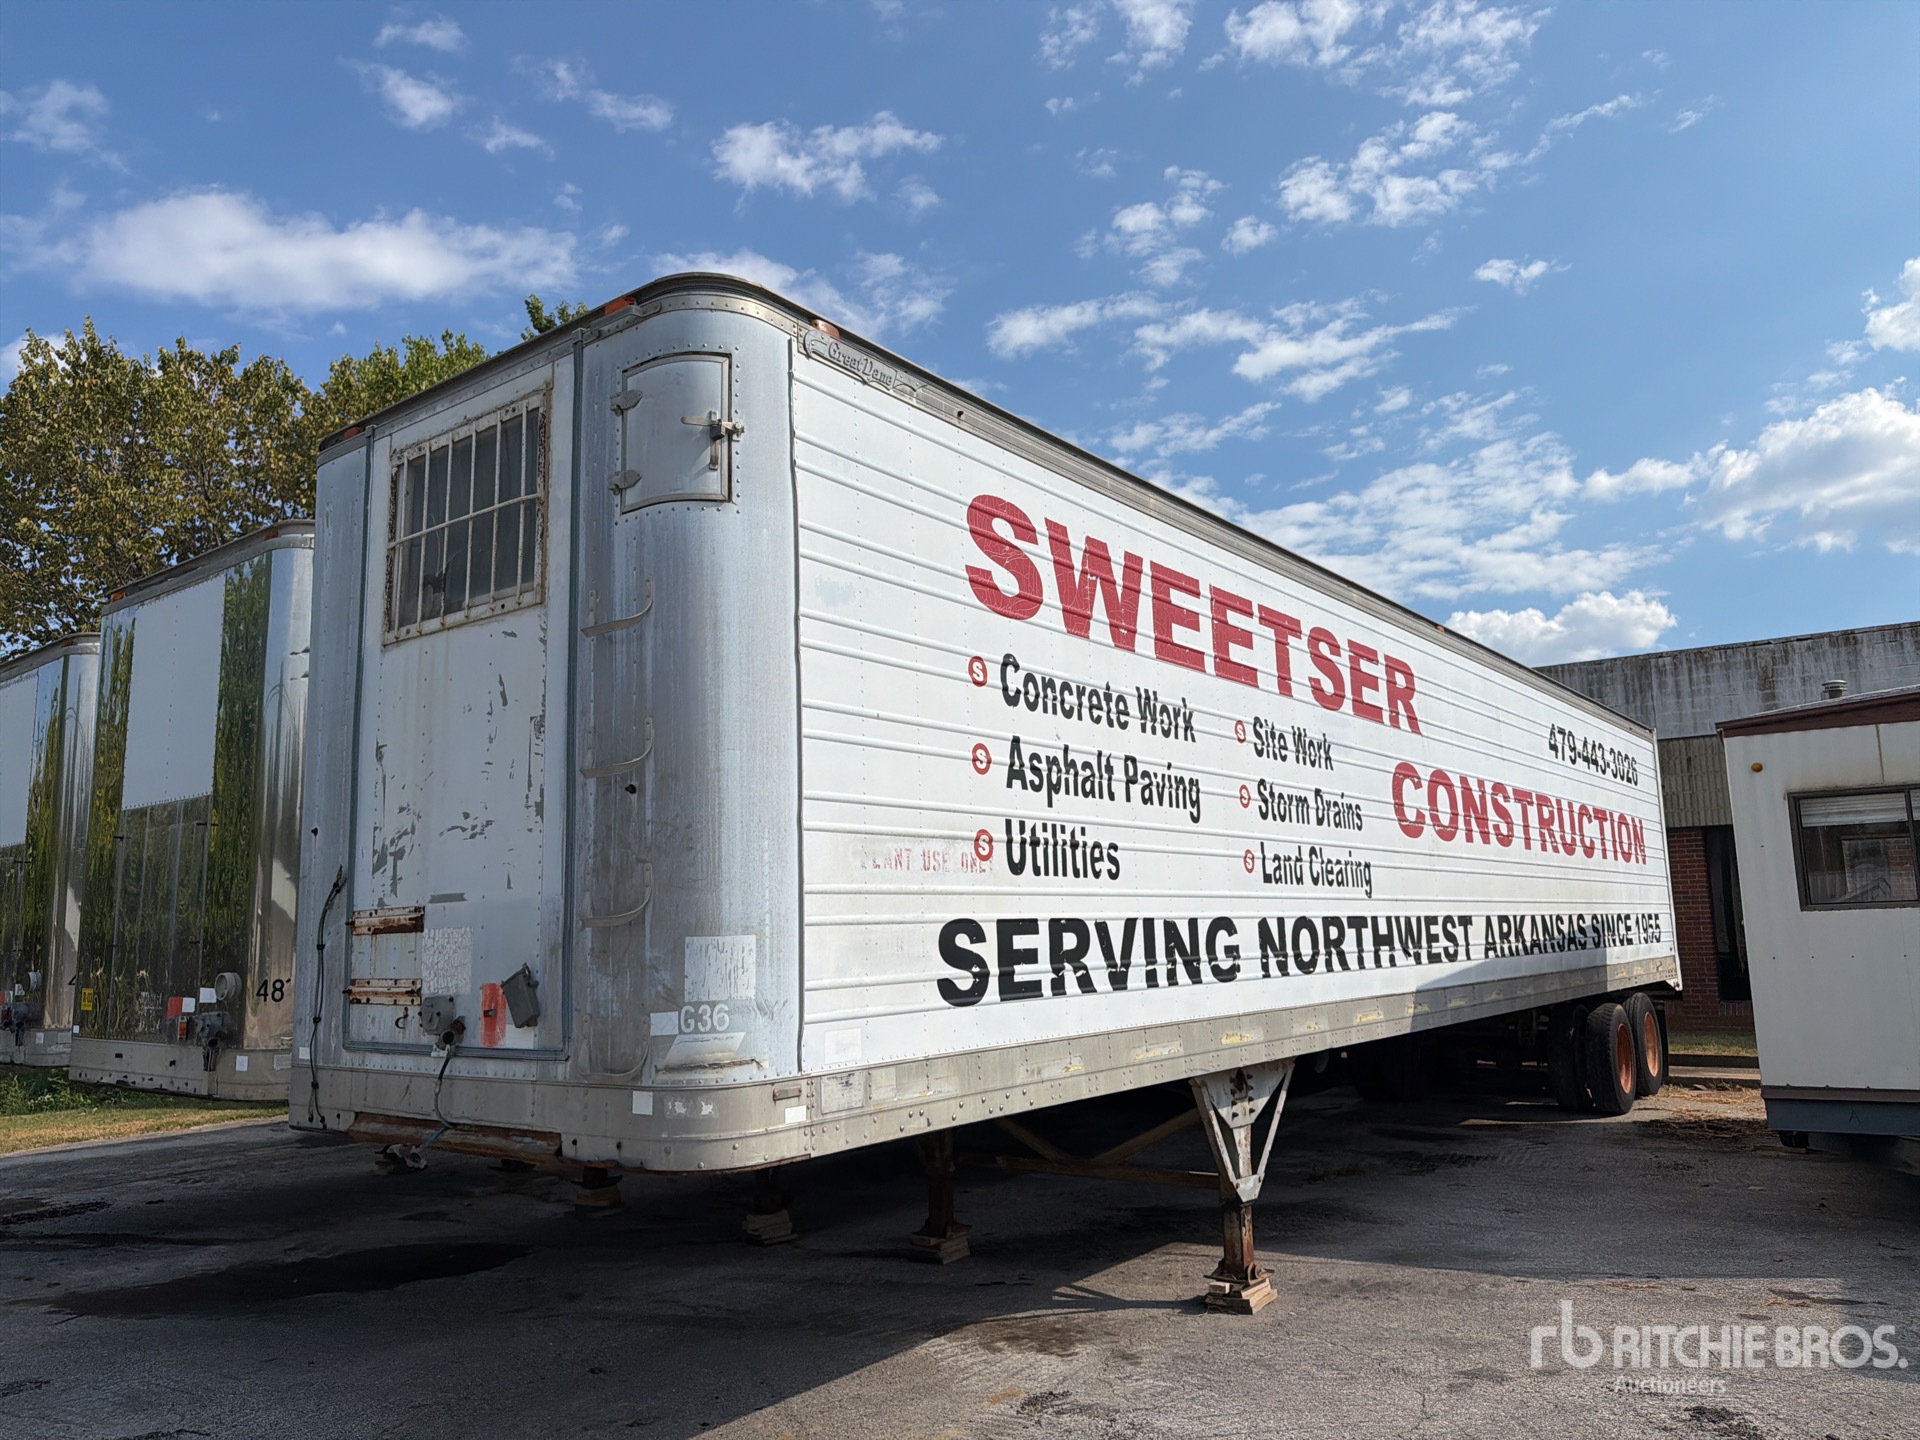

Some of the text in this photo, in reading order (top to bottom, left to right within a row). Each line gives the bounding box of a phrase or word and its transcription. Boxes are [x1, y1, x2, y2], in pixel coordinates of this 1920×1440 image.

[965, 494, 1422, 735] SWEETSER
[1000, 653, 1196, 743] Concrete Work
[1252, 716, 1334, 771] Site Work
[1548, 723, 1639, 787] 479-443-3026
[1006, 735, 1201, 824] Asphalt Paving
[1257, 778, 1363, 831] Storm Drains
[1391, 761, 1647, 865] CONSTRUCTION
[1004, 818, 1121, 881] Utilities
[1260, 841, 1373, 899] Land Clearing
[936, 916, 1242, 1007] SERVING
[1257, 914, 1473, 978] NORTHWEST
[1484, 913, 1587, 960] ARKANSAS
[1590, 913, 1633, 948] SINCE
[1635, 912, 1662, 944] 1955
[680, 1003, 730, 1033] G36
